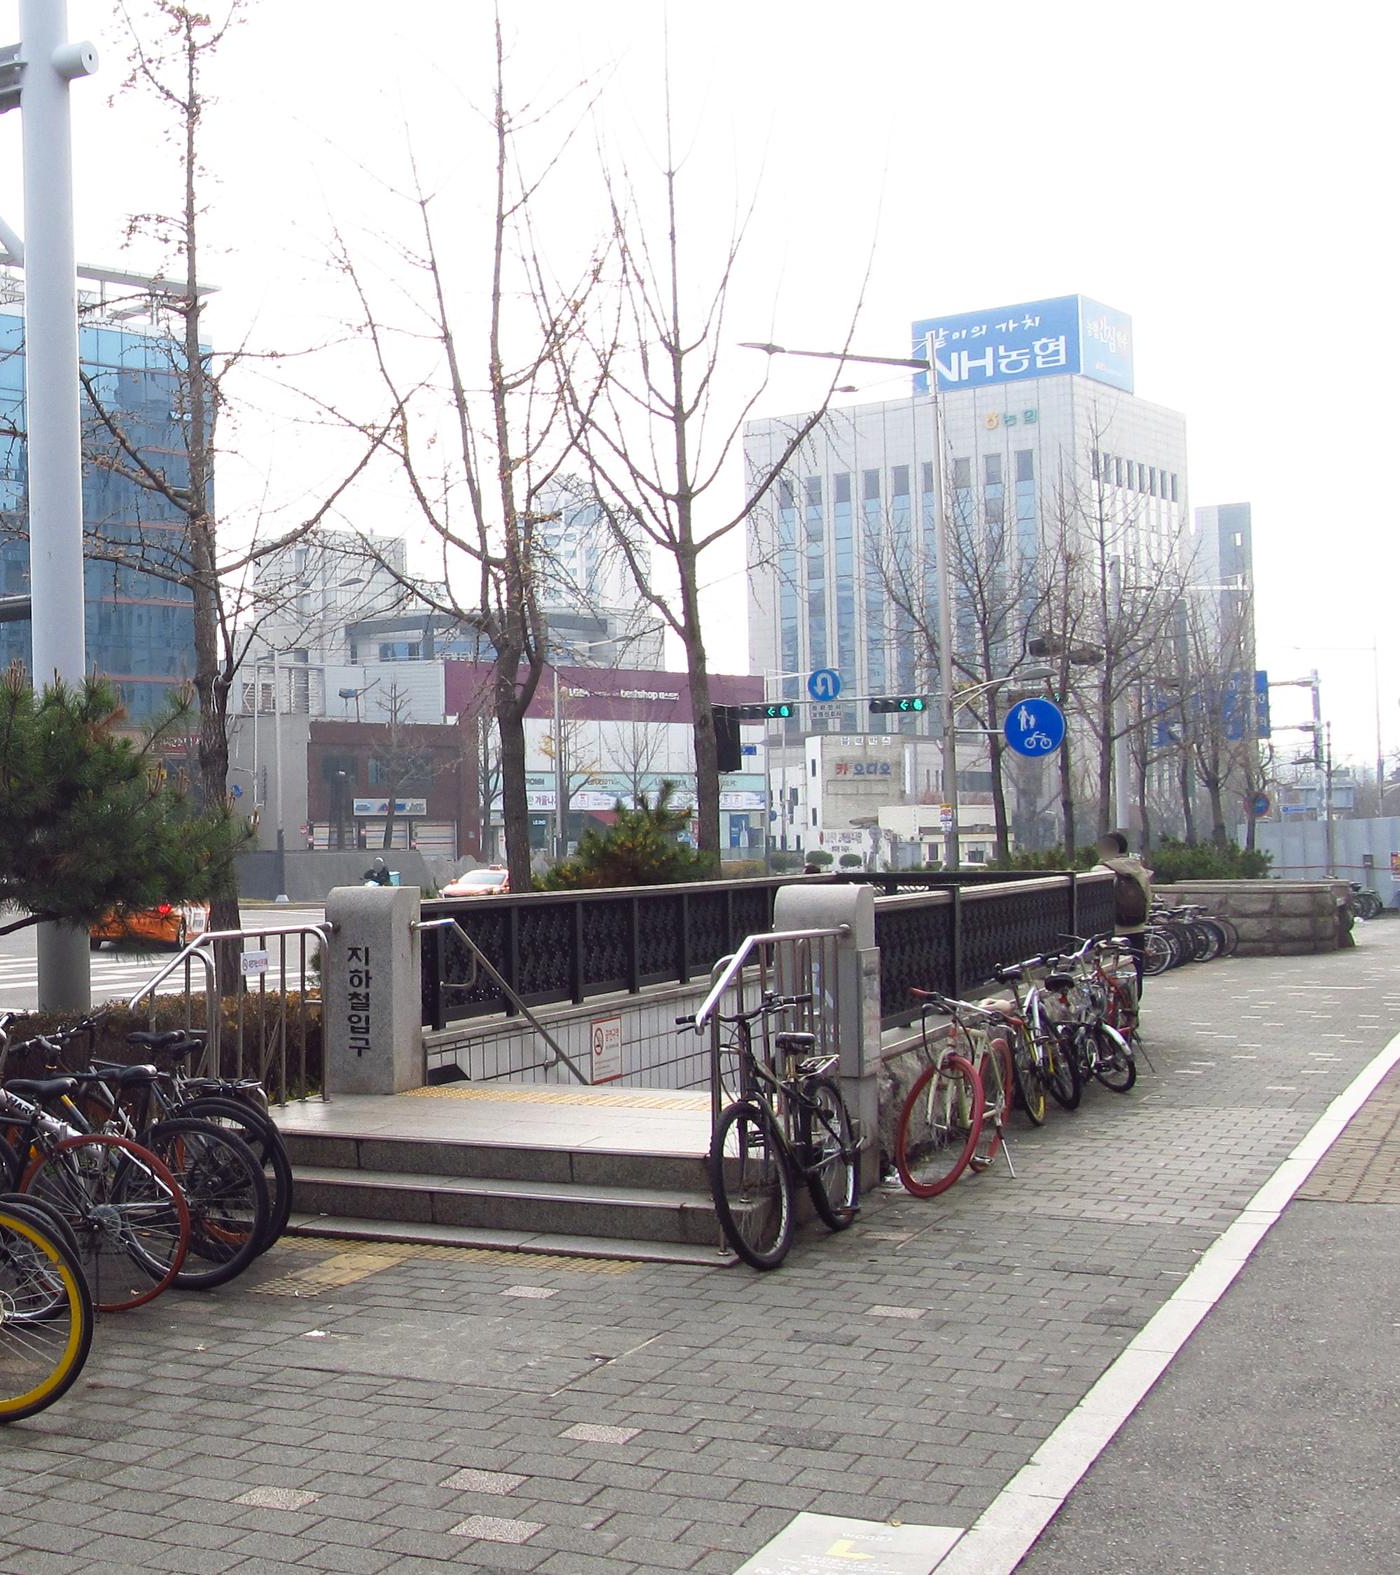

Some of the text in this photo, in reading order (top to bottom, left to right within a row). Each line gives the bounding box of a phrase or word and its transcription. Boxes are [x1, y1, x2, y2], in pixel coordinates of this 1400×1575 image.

[996, 314, 1041, 332] 가치
[927, 335, 1067, 386] NH농협
[835, 762, 891, 776] 카 오디오
[347, 945, 371, 1058] 지하철입구
